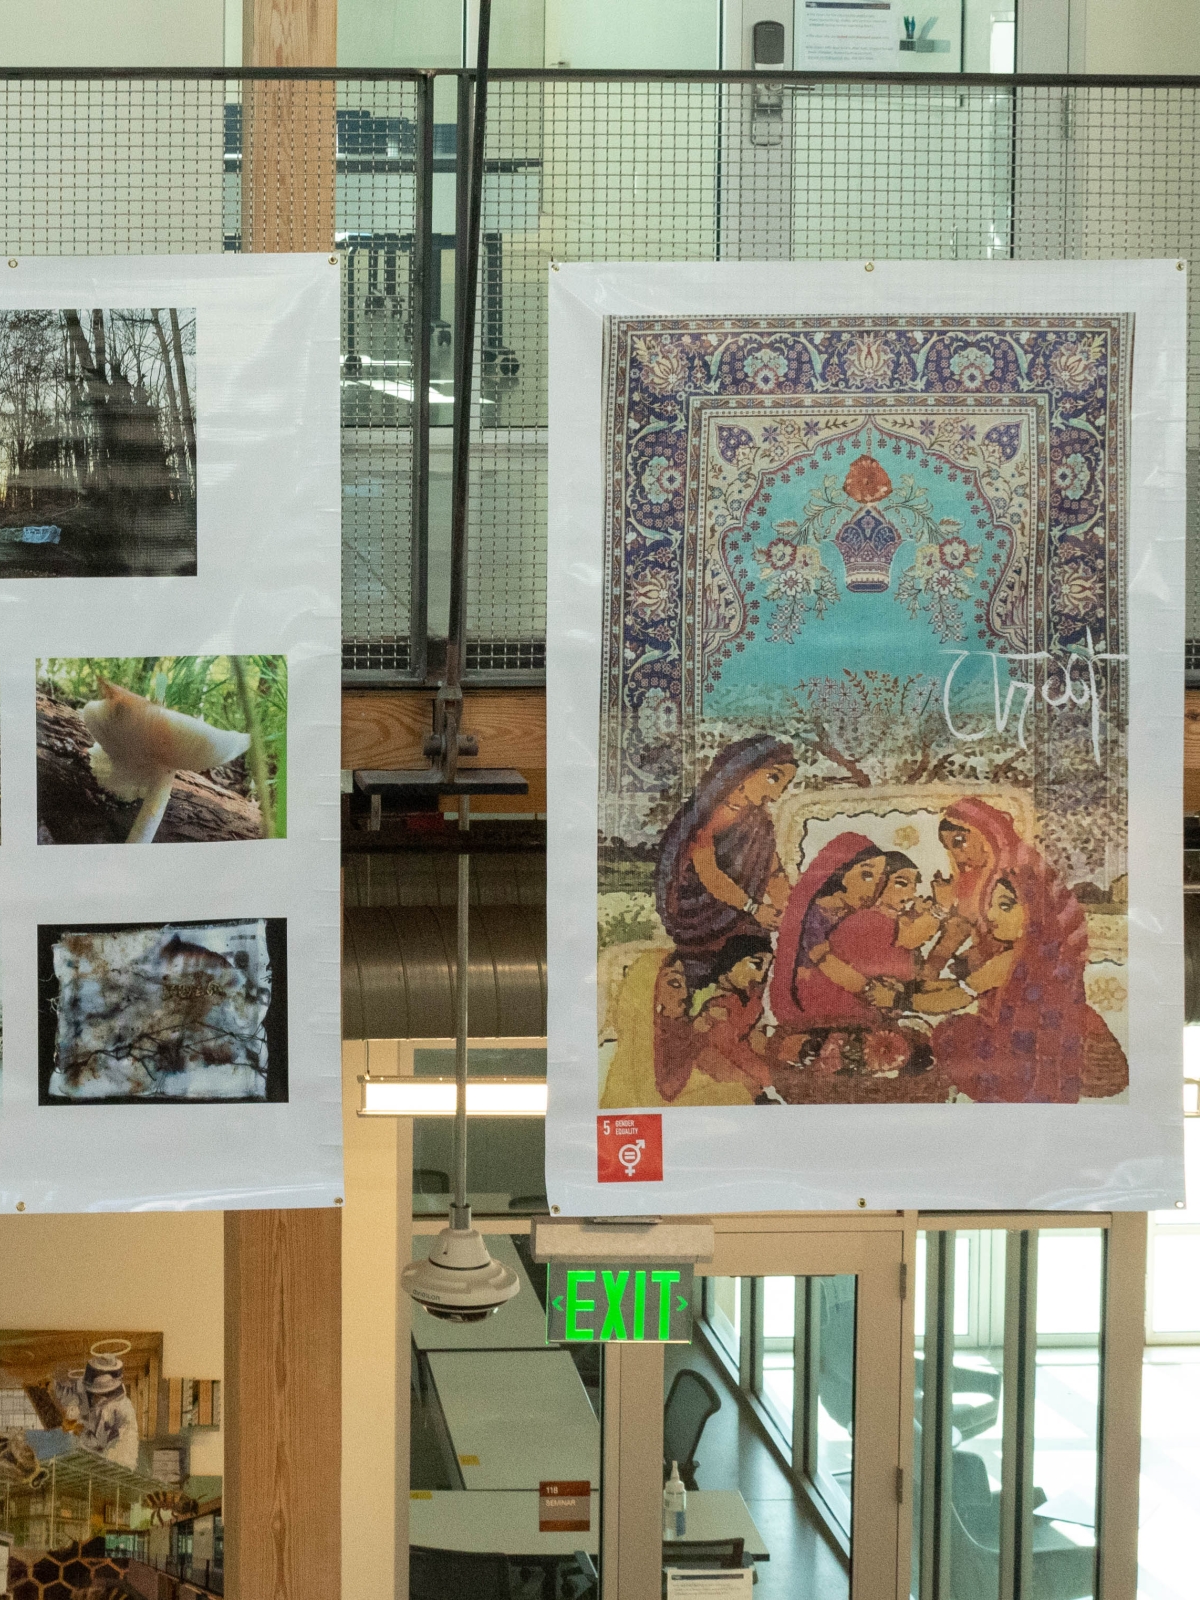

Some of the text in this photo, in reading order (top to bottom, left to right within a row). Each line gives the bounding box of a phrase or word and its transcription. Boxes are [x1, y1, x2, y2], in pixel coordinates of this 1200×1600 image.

[603, 1120, 611, 1135] 5
[615, 1127, 638, 1135] EQUALITY
[565, 1270, 681, 1341] EXIT
[545, 1499, 576, 1507] SEMINAR
